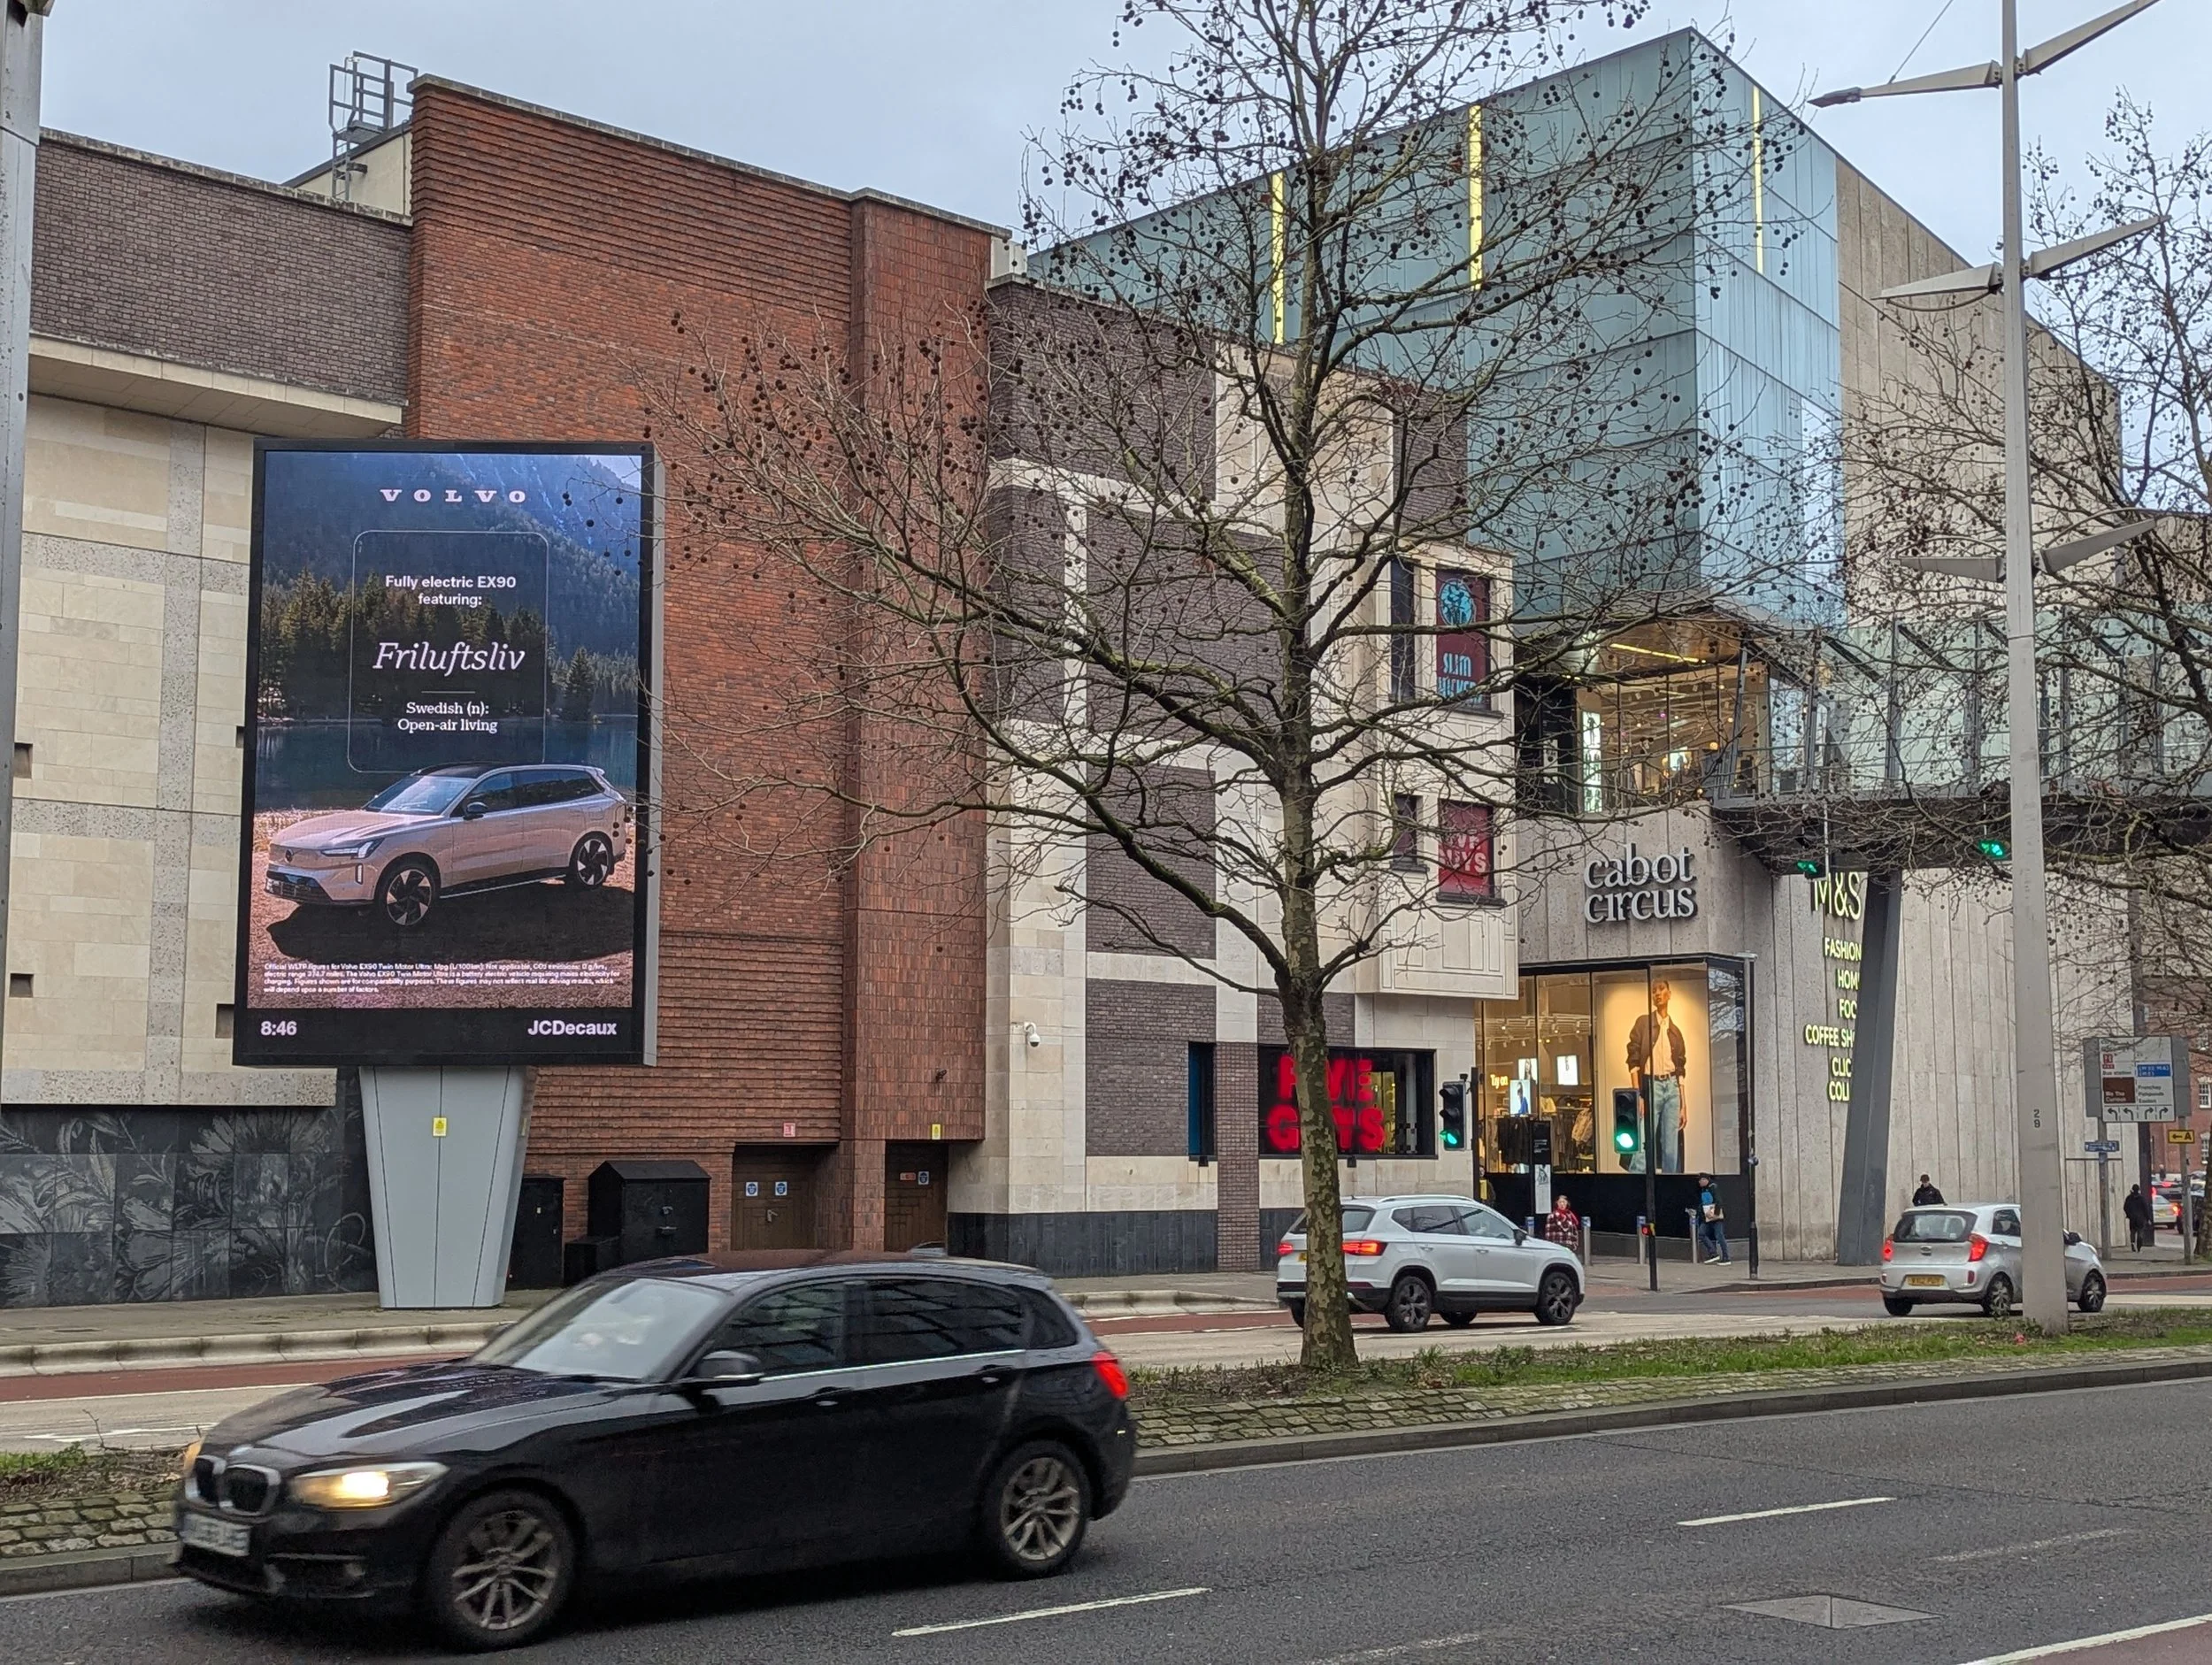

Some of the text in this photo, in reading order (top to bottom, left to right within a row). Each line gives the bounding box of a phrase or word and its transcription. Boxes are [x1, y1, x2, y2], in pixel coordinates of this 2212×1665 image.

[380, 489, 526, 503] VOLVO
[385, 575, 516, 590] Fully electric EX90
[419, 594, 482, 608] featuring:
[372, 641, 526, 677] Friluftsliv
[1443, 653, 1471, 677] SLIM
[406, 701, 489, 717] Swedish (n):
[397, 718, 498, 734] Open-air living
[1584, 843, 1693, 888] cabot
[1584, 887, 1694, 923] circus
[1815, 871, 1862, 921] M&S
[1824, 937, 1862, 961] FASHION
[1838, 969, 1861, 990] HOM
[261, 1021, 297, 1036] 8:46
[528, 1020, 617, 1036] JCDecaux
[1806, 1024, 1855, 1047] COFFEE SH
[1279, 1055, 1373, 1101] FVE
[1832, 1057, 1852, 1078] CLIC
[1268, 1104, 1386, 1151] GYS
[2184, 1132, 2192, 1140] A
